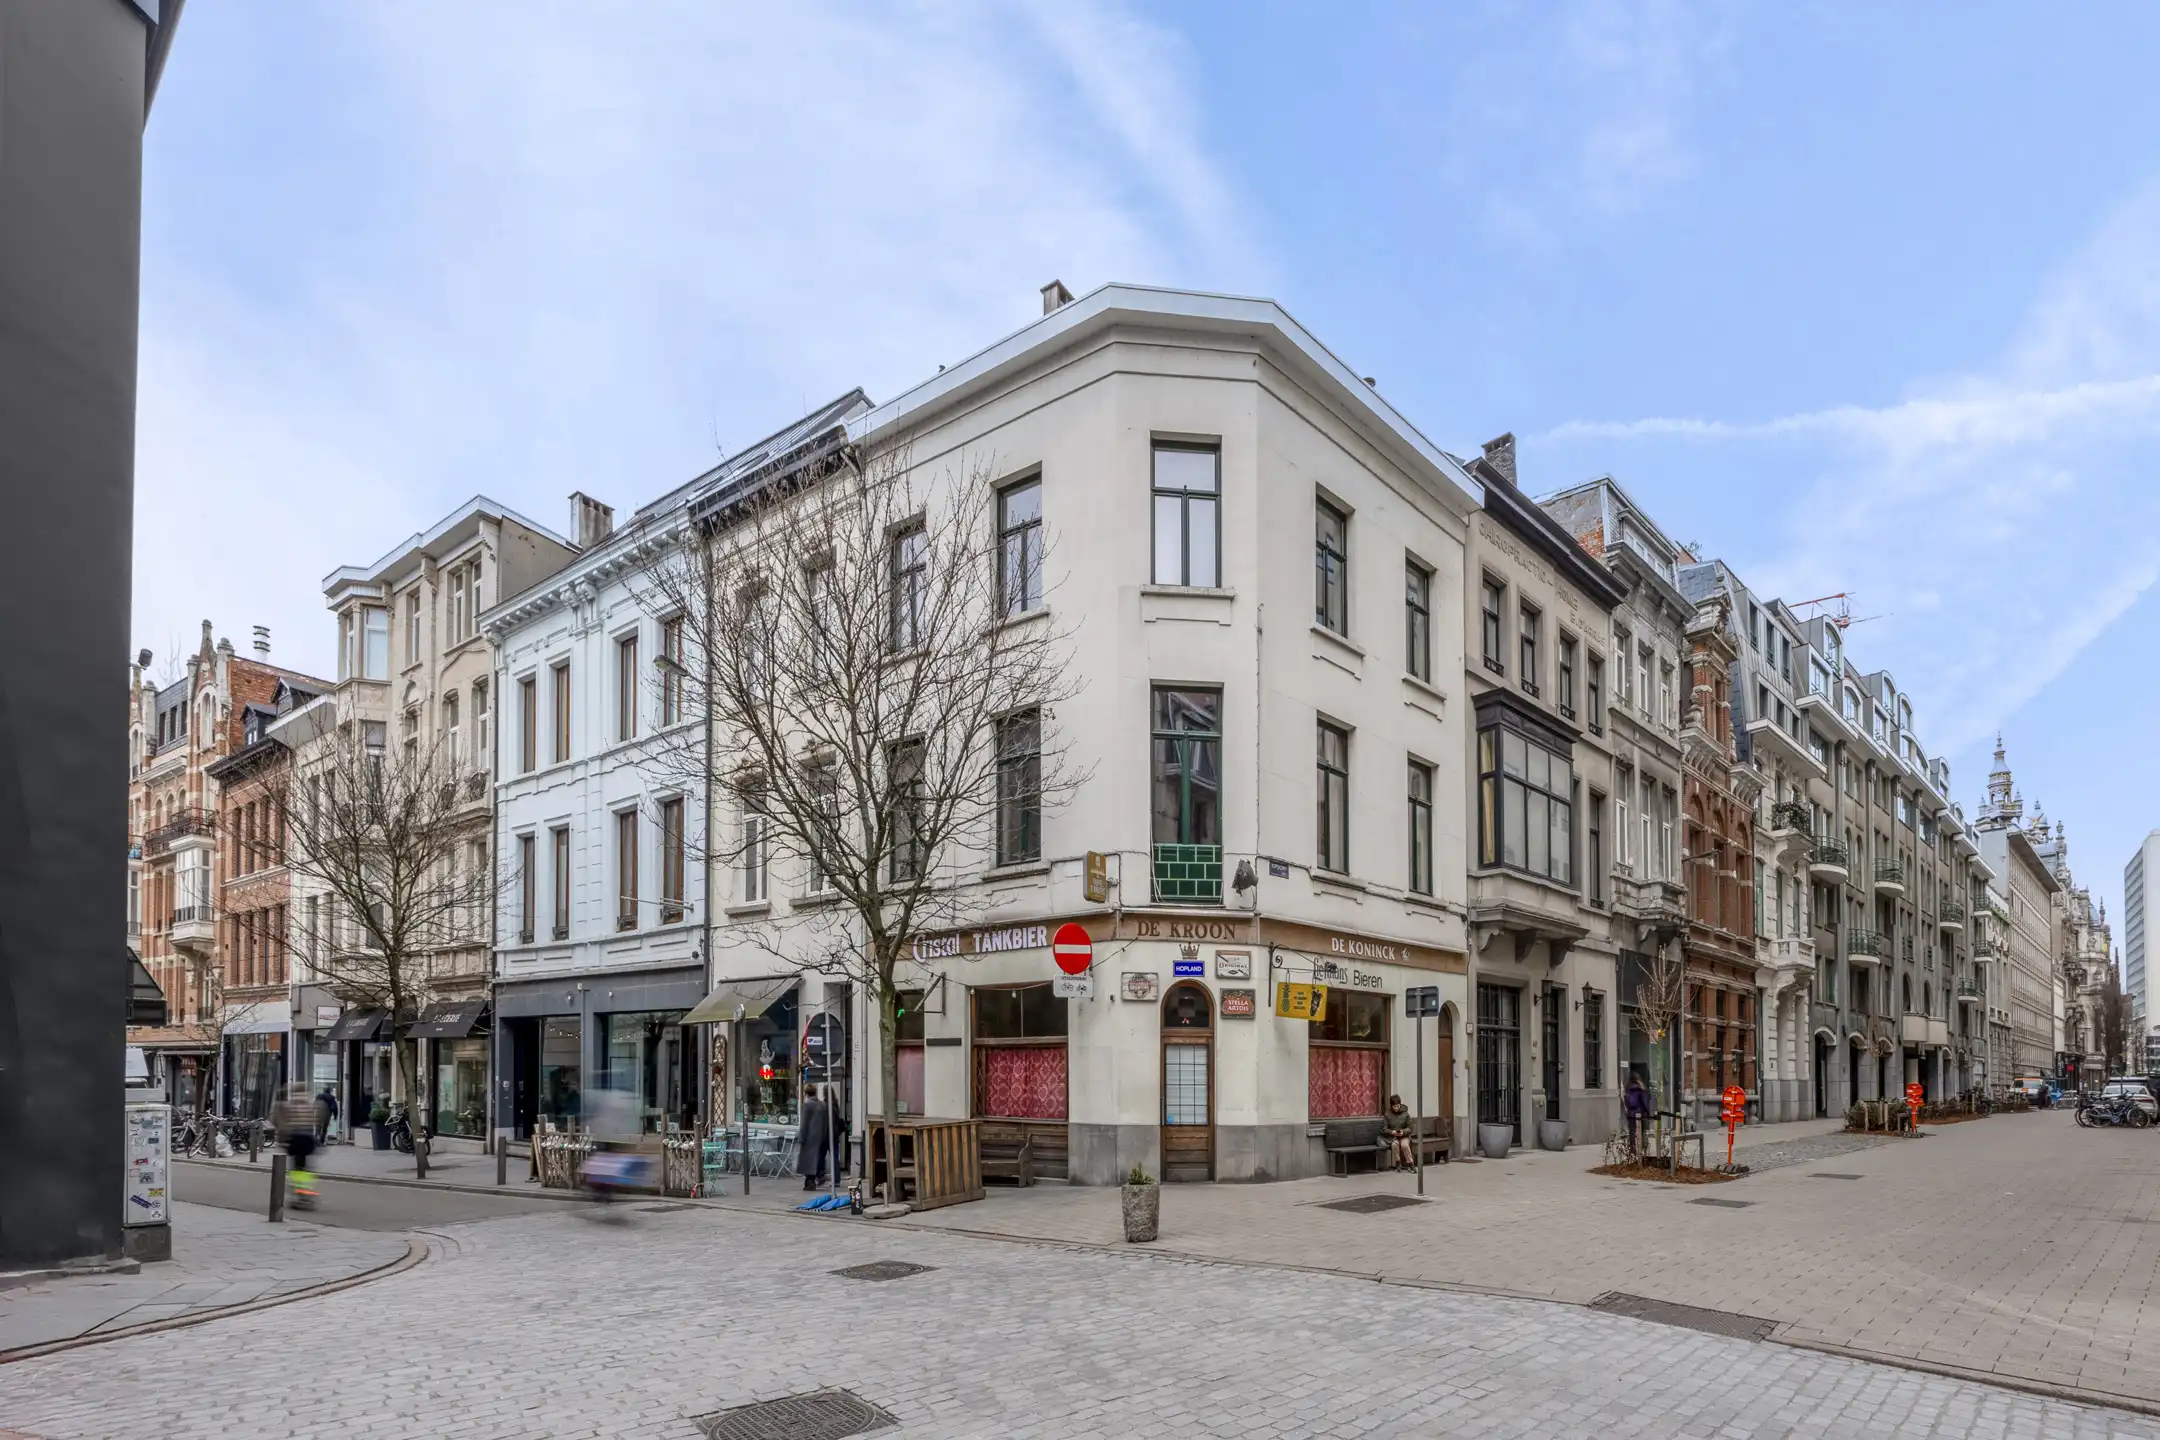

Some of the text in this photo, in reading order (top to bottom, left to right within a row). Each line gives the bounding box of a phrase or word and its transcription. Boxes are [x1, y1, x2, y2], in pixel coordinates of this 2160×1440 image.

[1556, 587, 1578, 612] HOME
[1137, 920, 1236, 940] DE KROON
[912, 925, 1048, 963] Cristal TANKBIER
[1331, 937, 1396, 961] DE KONINCK
[1175, 965, 1203, 973] HOPLAND
[1353, 969, 1383, 989] Bieren
